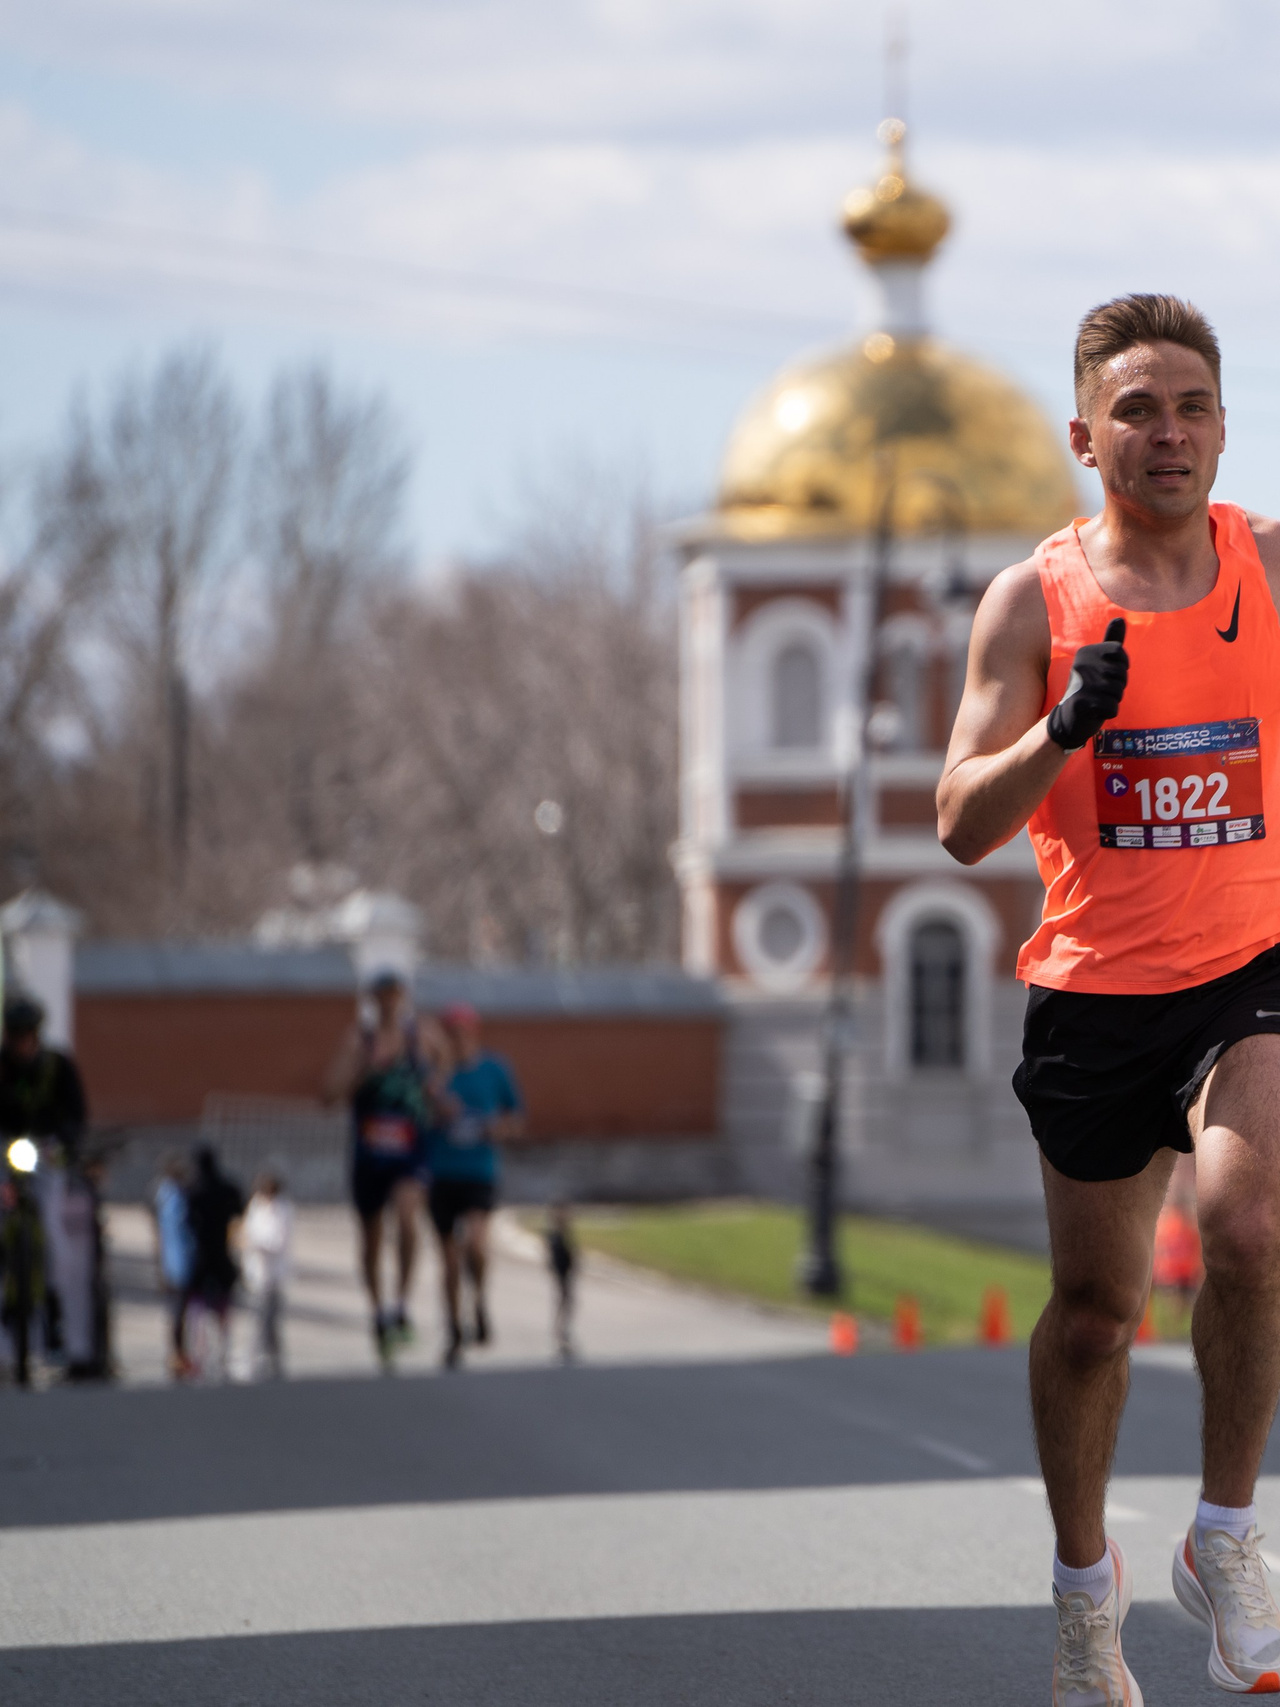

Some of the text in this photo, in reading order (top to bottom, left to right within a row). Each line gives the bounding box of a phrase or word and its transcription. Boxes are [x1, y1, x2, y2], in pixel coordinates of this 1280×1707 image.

[1145, 729, 1210, 743] Я ПРОСТО
[1145, 737, 1211, 751] КОСМОС
[1102, 762, 1111, 770] 10
[1135, 772, 1231, 821] 1822
